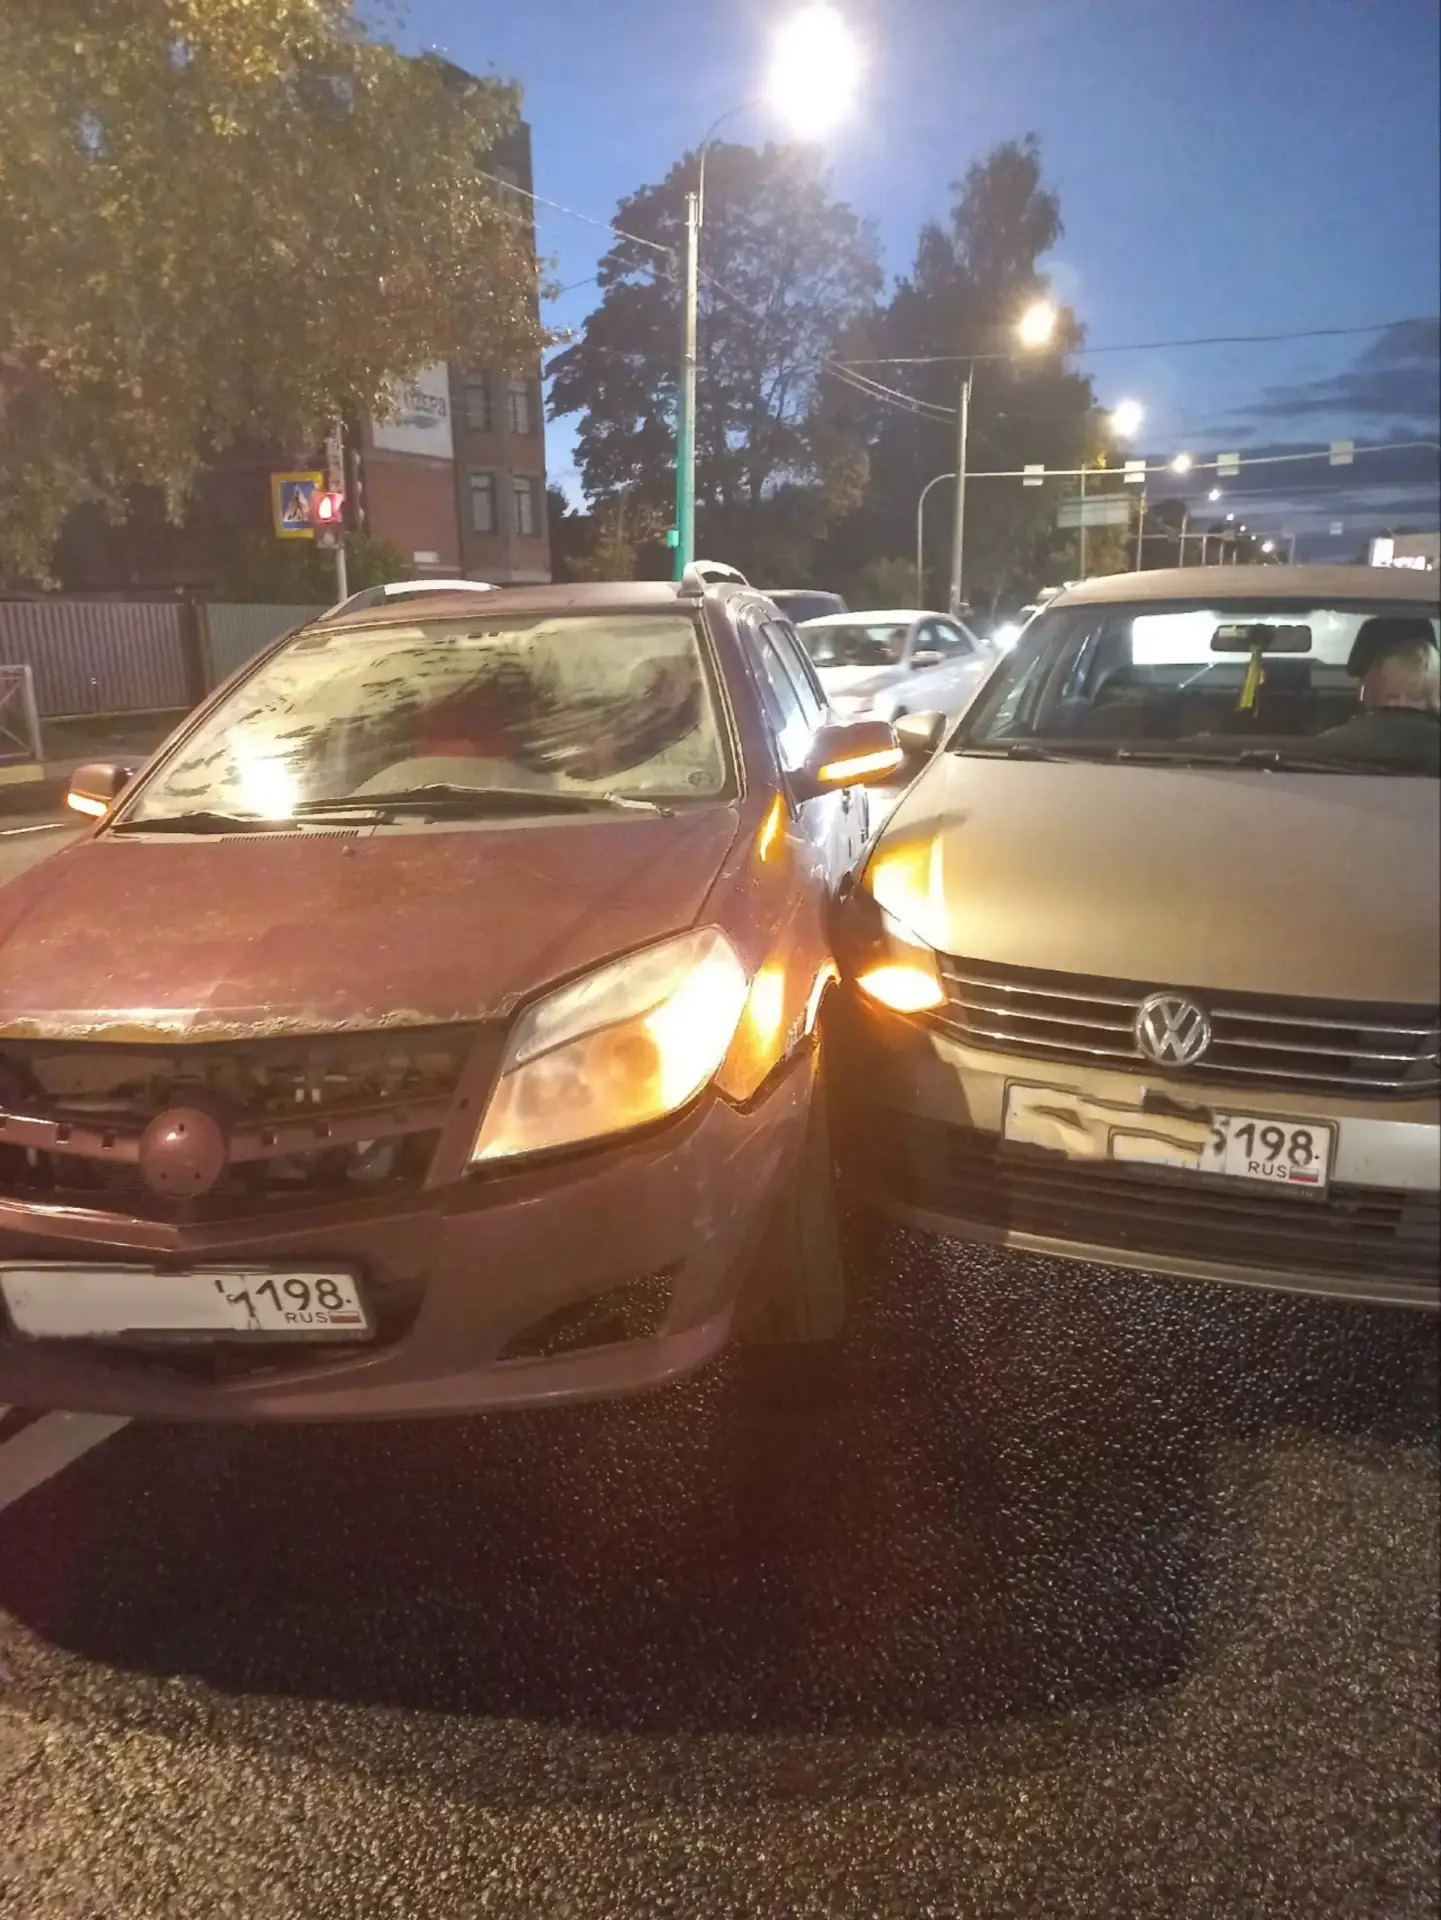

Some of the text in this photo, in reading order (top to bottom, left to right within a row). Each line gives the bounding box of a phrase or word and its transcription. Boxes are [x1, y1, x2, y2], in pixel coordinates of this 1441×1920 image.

[1234, 1123, 1313, 1167] 198
[1248, 1161, 1287, 1178] RUS
[256, 1278, 343, 1310] 198
[285, 1312, 328, 1324] RUS
